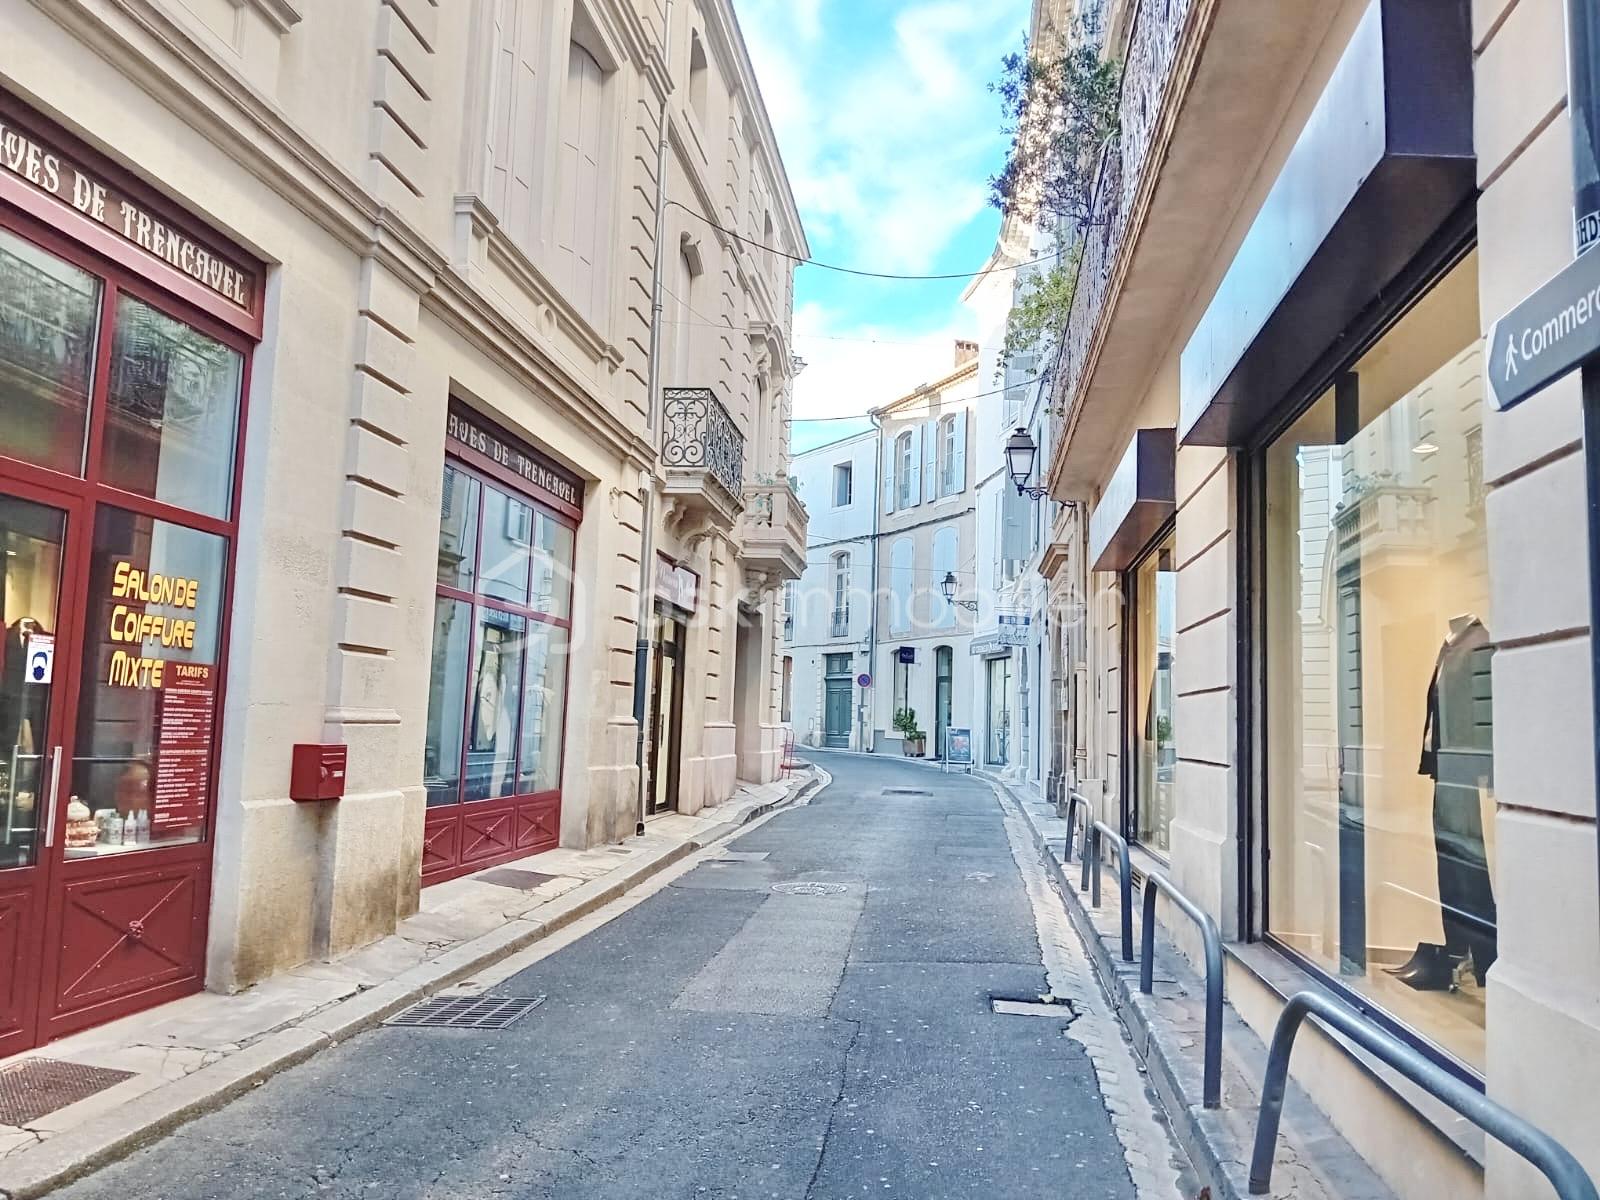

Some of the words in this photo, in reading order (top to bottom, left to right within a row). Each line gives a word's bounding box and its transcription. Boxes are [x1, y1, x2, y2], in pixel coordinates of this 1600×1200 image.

[73, 170, 107, 222] DE
[120, 200, 245, 305] TRENCAVEL
[493, 440, 509, 467] DE
[517, 454, 576, 505] TRENCAVEL
[110, 605, 195, 648] COIFFURE
[108, 650, 164, 688] MIXTE
[175, 665, 209, 679] TARIFS
